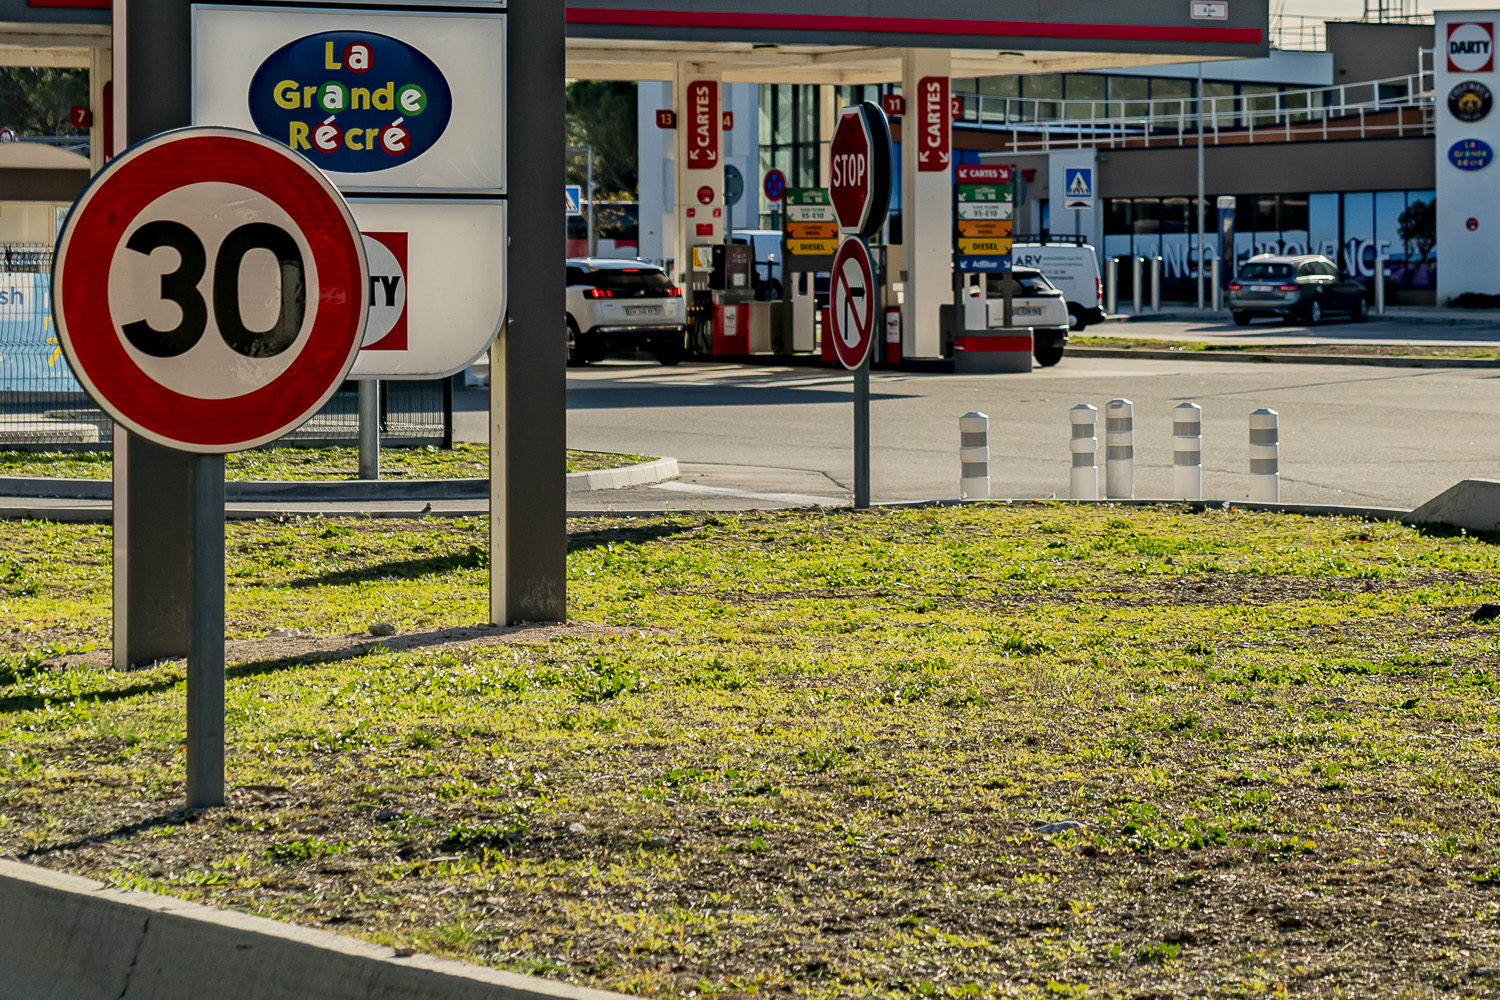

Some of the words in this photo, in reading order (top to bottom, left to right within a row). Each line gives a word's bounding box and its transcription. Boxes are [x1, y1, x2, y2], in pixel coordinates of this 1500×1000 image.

[1449, 40, 1490, 54] DARTY
[325, 40, 370, 70] La
[273, 79, 422, 112] Grande
[888, 98, 901, 111] 11
[951, 101, 960, 114] 2
[77, 109, 86, 123] 7
[660, 113, 672, 125] 13
[696, 85, 710, 147] CARTES
[723, 115, 731, 127] 4
[927, 82, 942, 148] CARTES
[289, 114, 406, 152] Récré
[833, 153, 866, 188] STOP
[969, 169, 999, 178] CARTES
[800, 243, 825, 251] DIESEL
[972, 243, 998, 251] DIESEL
[121, 219, 308, 358] 30
